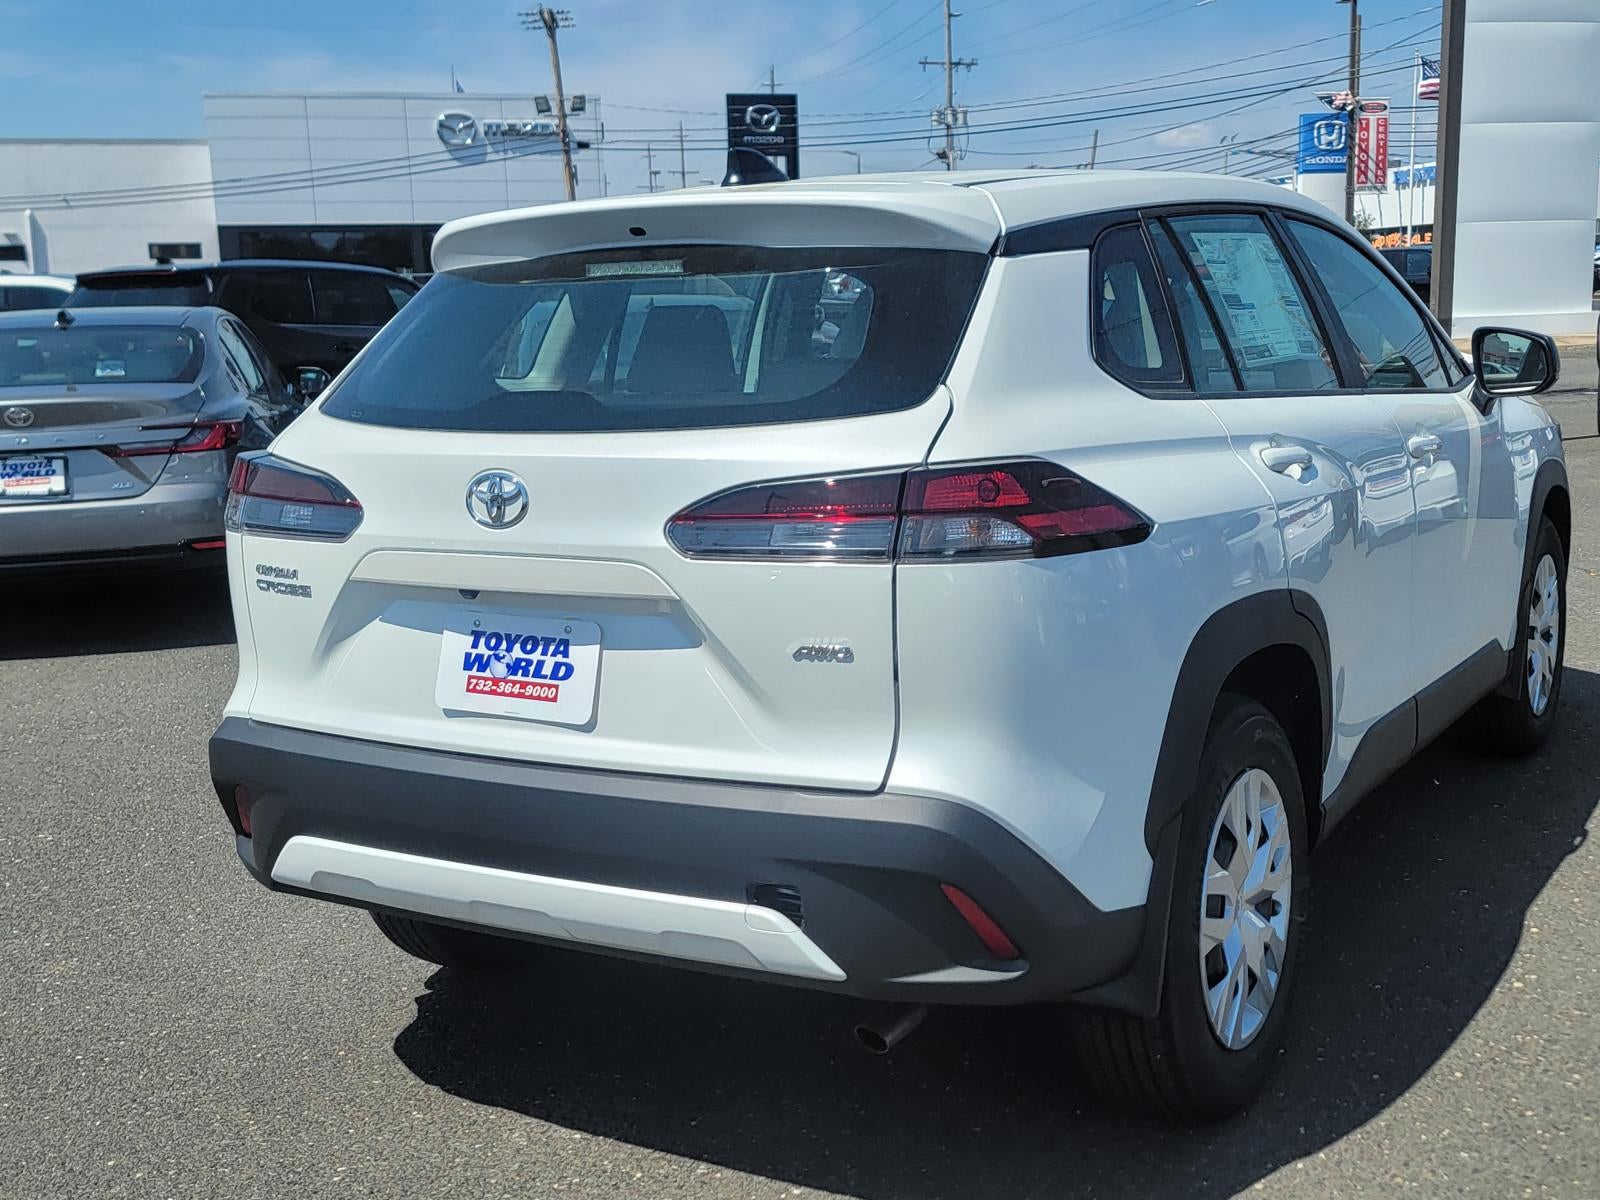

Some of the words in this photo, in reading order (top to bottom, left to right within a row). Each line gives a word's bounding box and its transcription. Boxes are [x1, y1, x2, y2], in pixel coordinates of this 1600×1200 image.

[1359, 120, 1368, 182] TOYOTA
[1376, 119, 1385, 182] CERTIFIED
[2, 460, 53, 472] TOYOTA
[470, 629, 570, 659] TOYOTA
[468, 678, 557, 699] 732-364-9000
